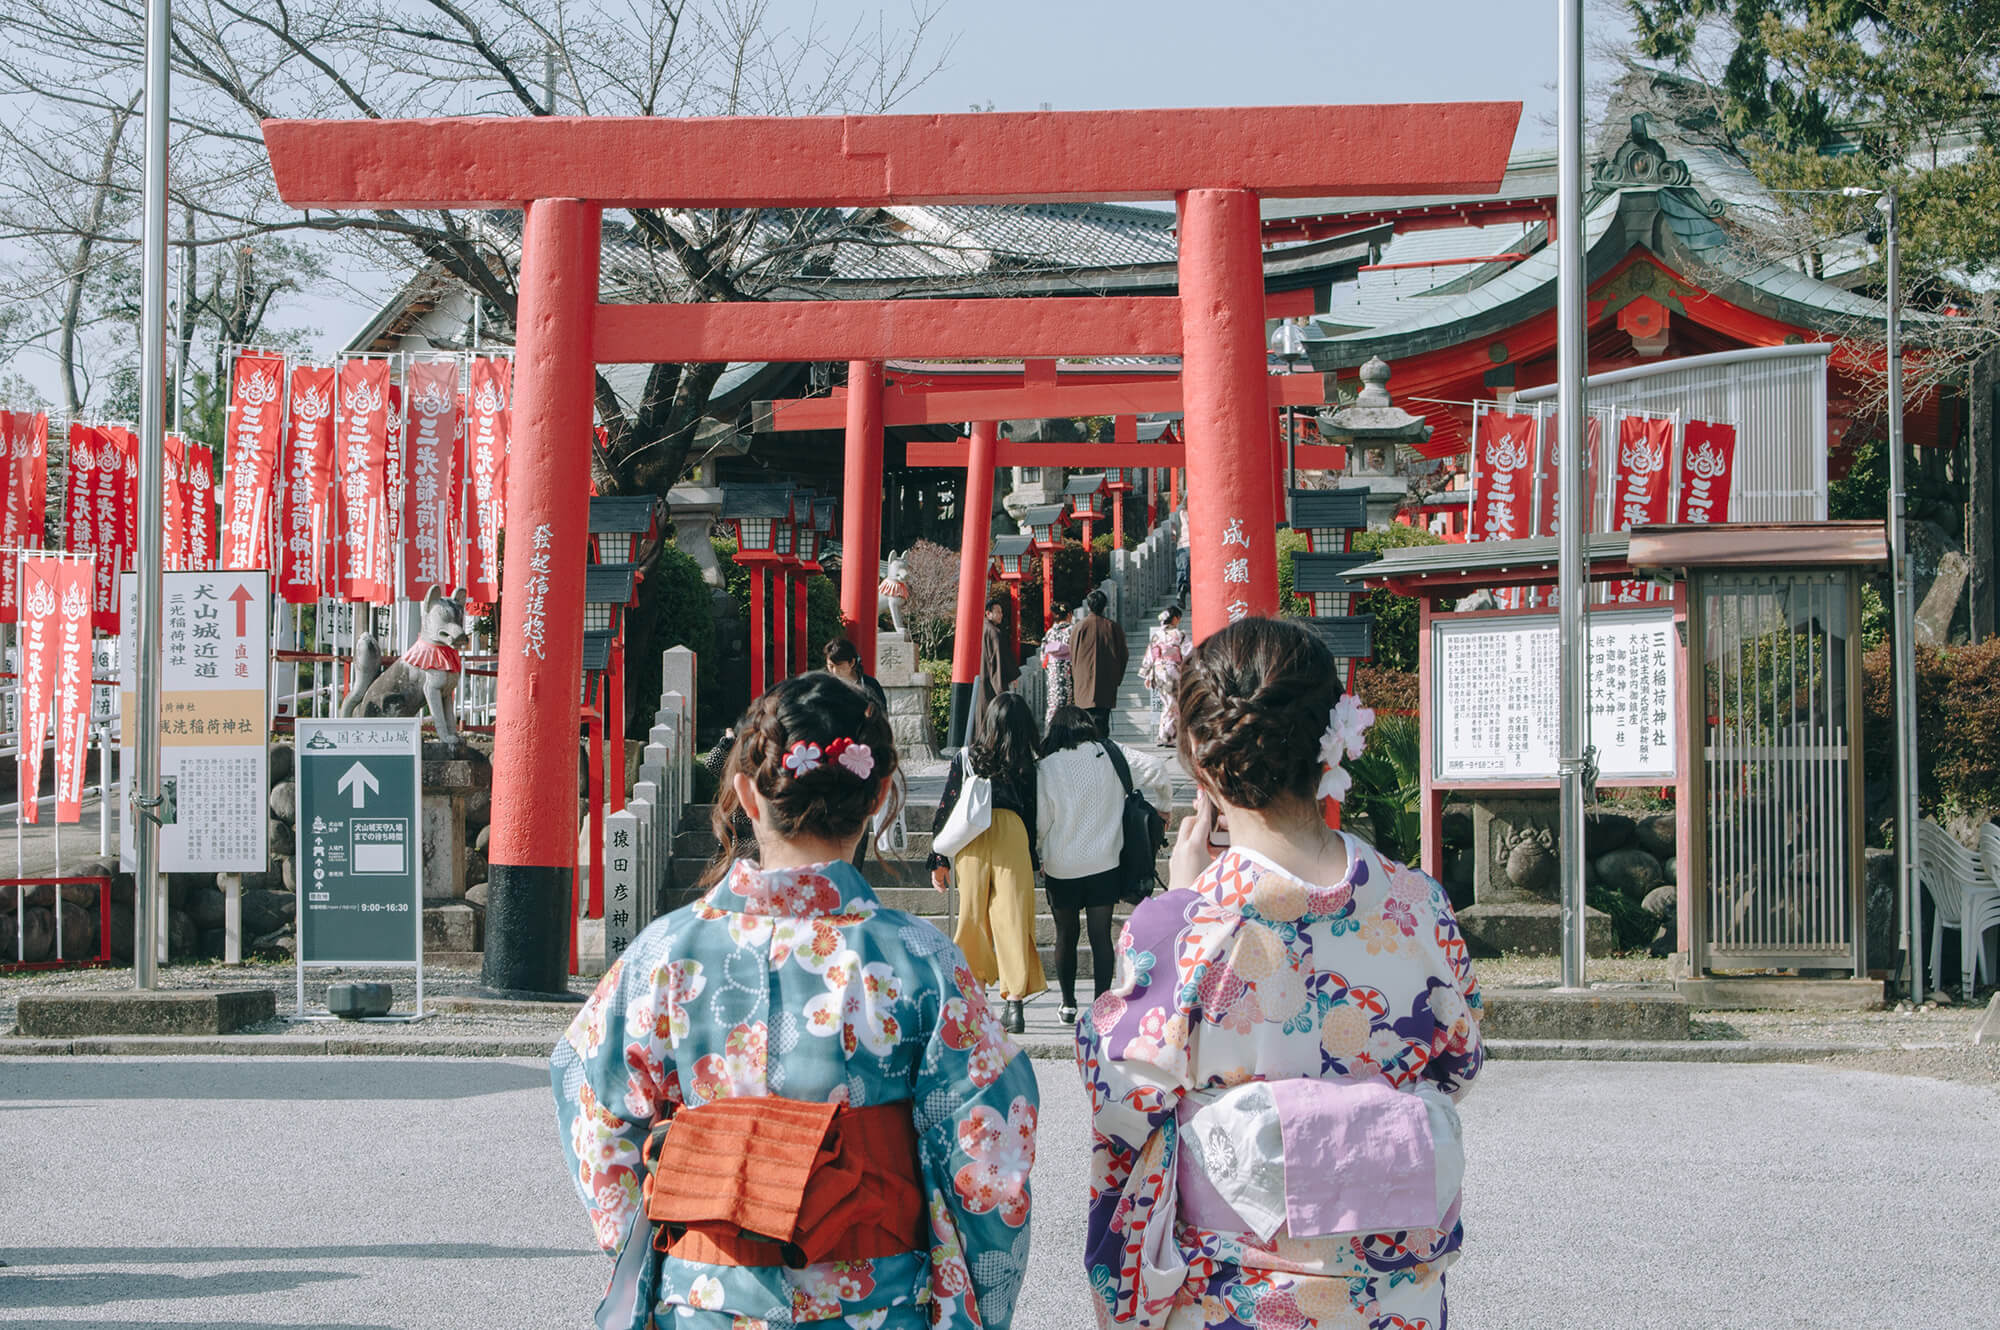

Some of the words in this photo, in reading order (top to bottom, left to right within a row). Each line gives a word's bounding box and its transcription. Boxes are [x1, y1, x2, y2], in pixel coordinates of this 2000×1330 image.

[169, 593, 186, 666] 三光稲荷神社
[192, 583, 221, 678] 犬山城近道
[234, 644, 249, 678] 直進
[881, 646, 902, 669] 奉
[1652, 631, 1667, 746] 三光稲荷神社
[161, 702, 196, 713] 荷神社
[337, 730, 409, 744] 国宝犬山城
[354, 823, 403, 832] 犬山城天守入場
[354, 833, 403, 841] までの待ち時間
[612, 829, 630, 953] 猿田彦神社
